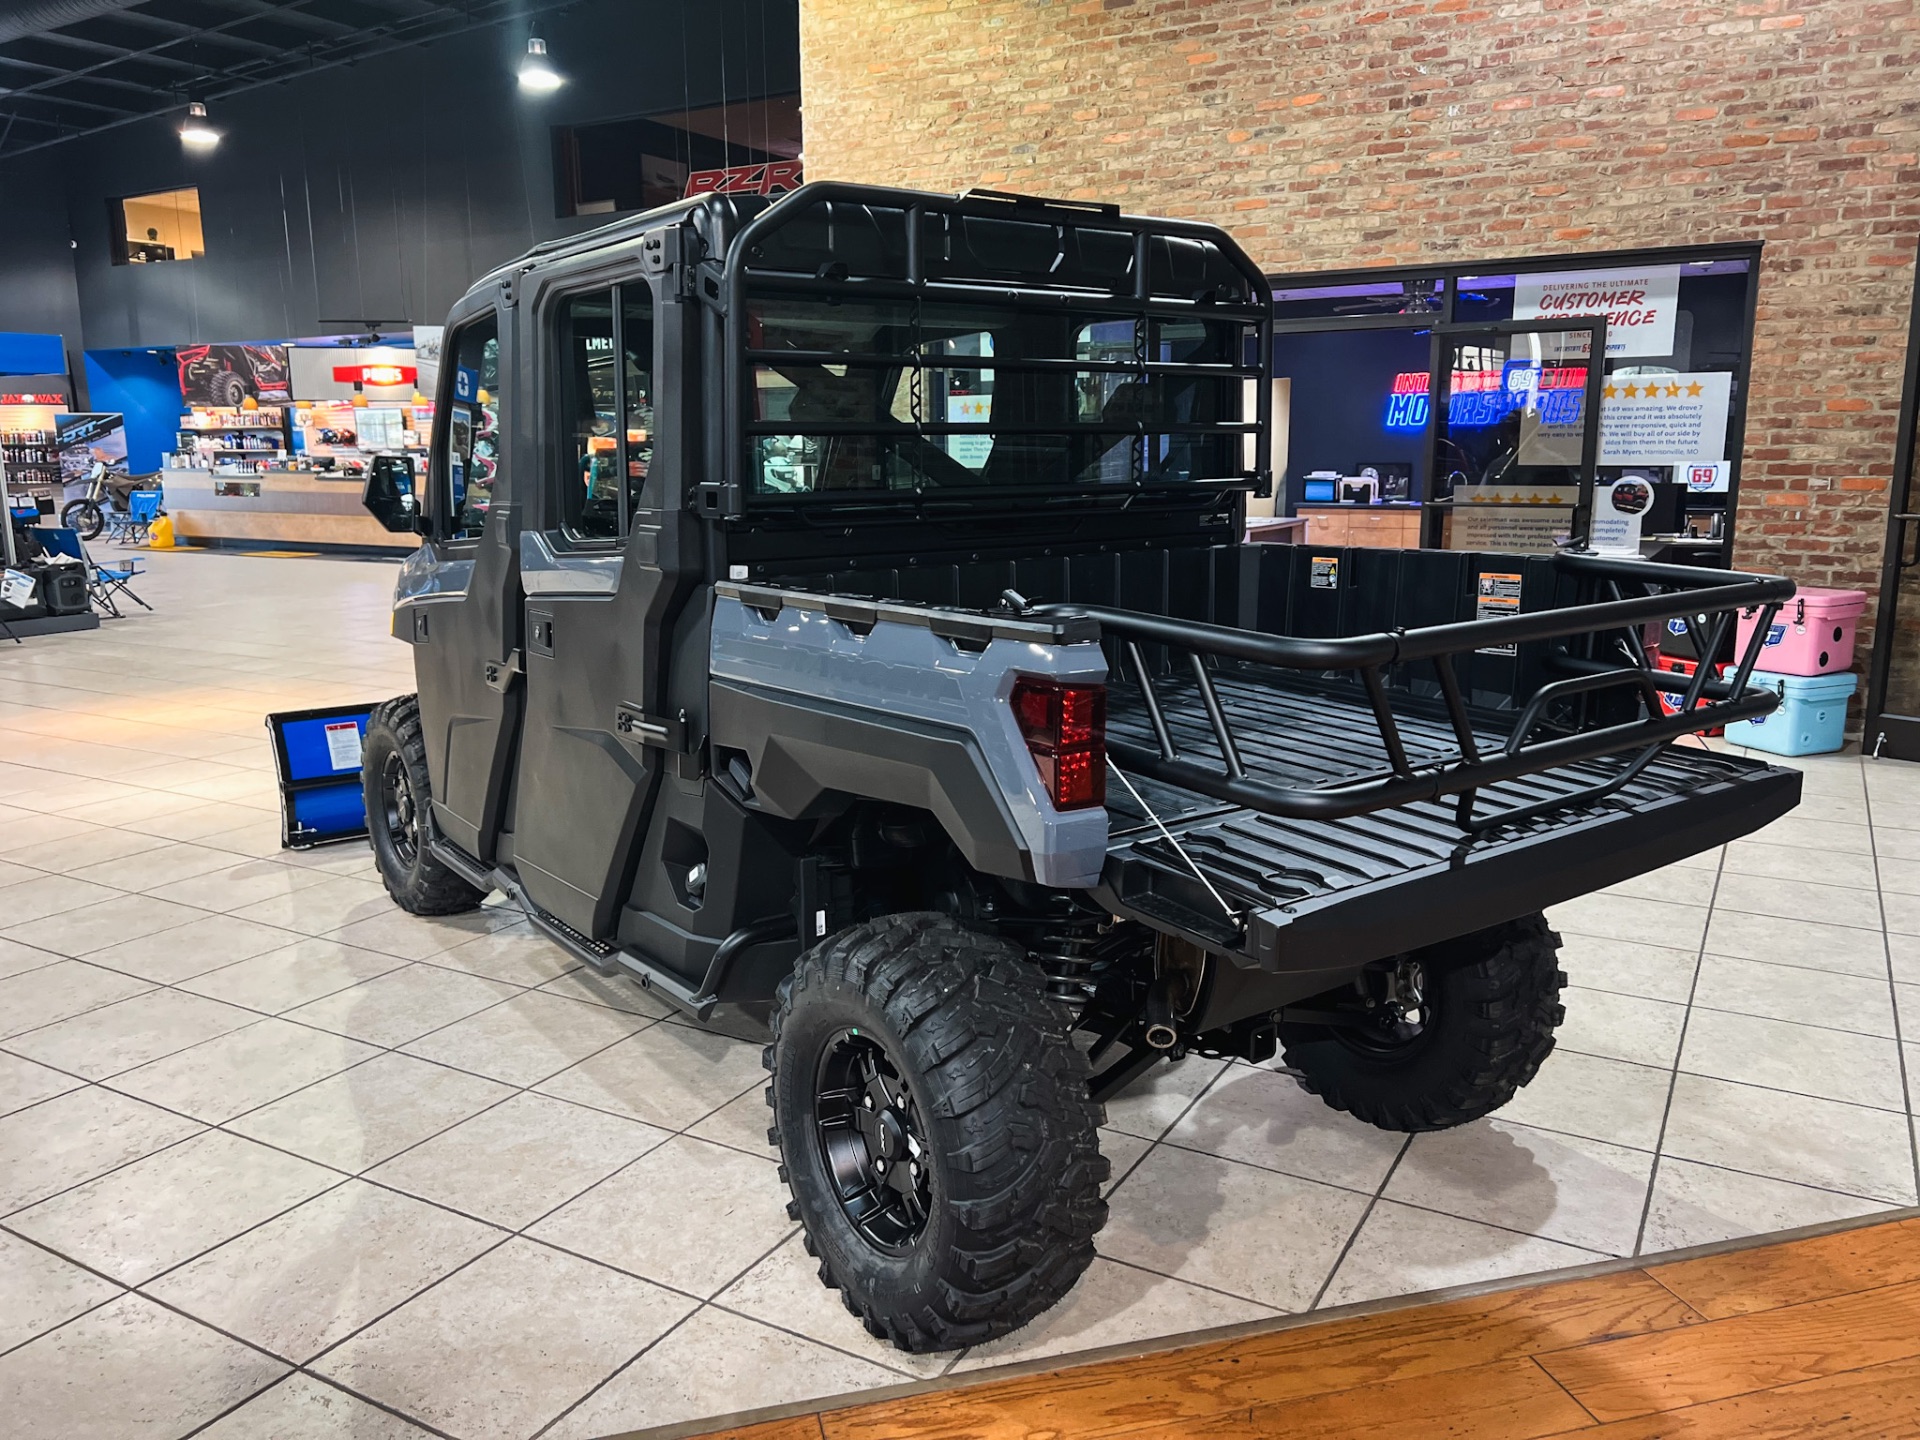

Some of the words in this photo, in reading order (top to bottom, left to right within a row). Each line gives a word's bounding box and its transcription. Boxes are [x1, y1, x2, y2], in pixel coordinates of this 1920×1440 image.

[683, 160, 803, 198] RZR
[1543, 282, 1589, 291] DELIVERING
[1610, 278, 1649, 288] ULTIMATE
[1539, 289, 1646, 311] CUSTOMER
[33, 394, 64, 404] WAX
[1692, 468, 1713, 483] 69
